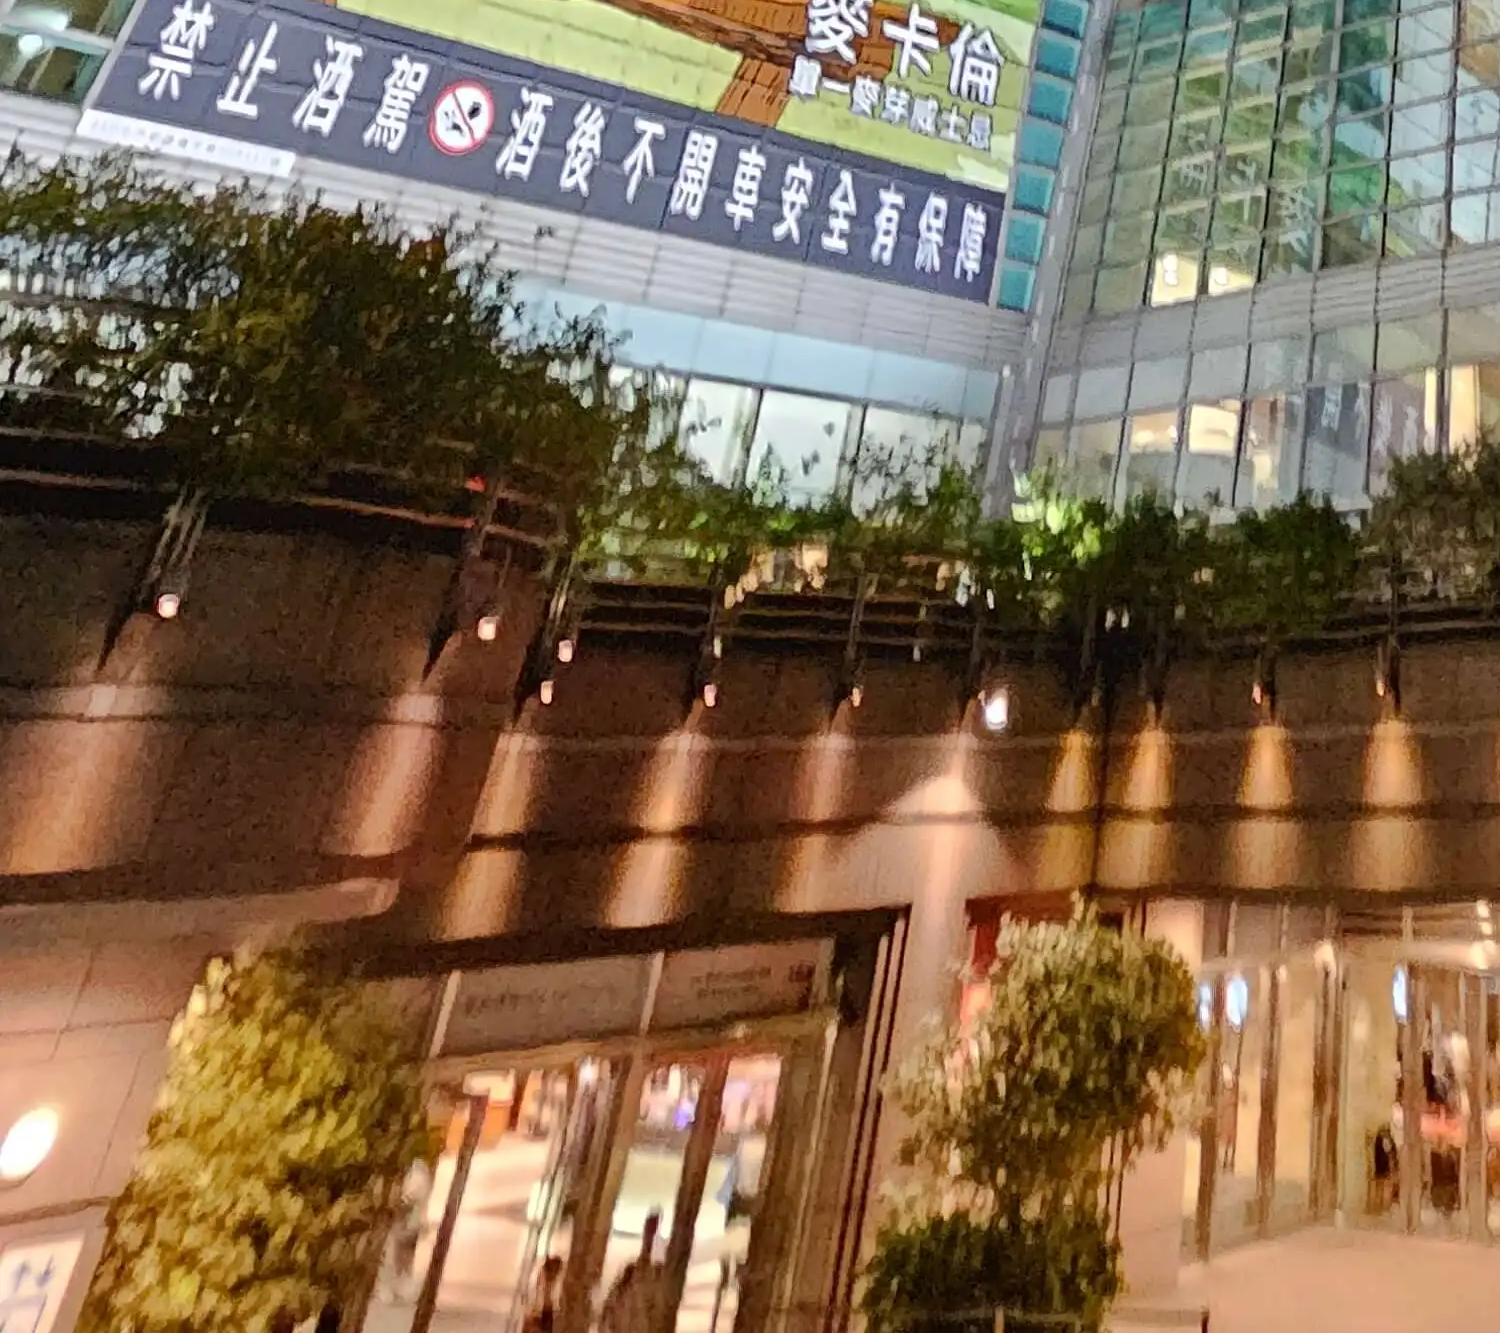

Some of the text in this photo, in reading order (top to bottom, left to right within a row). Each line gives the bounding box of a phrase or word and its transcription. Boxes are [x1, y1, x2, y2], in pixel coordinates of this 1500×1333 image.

[494, 84, 988, 283] 酒後不開車安全有保障
